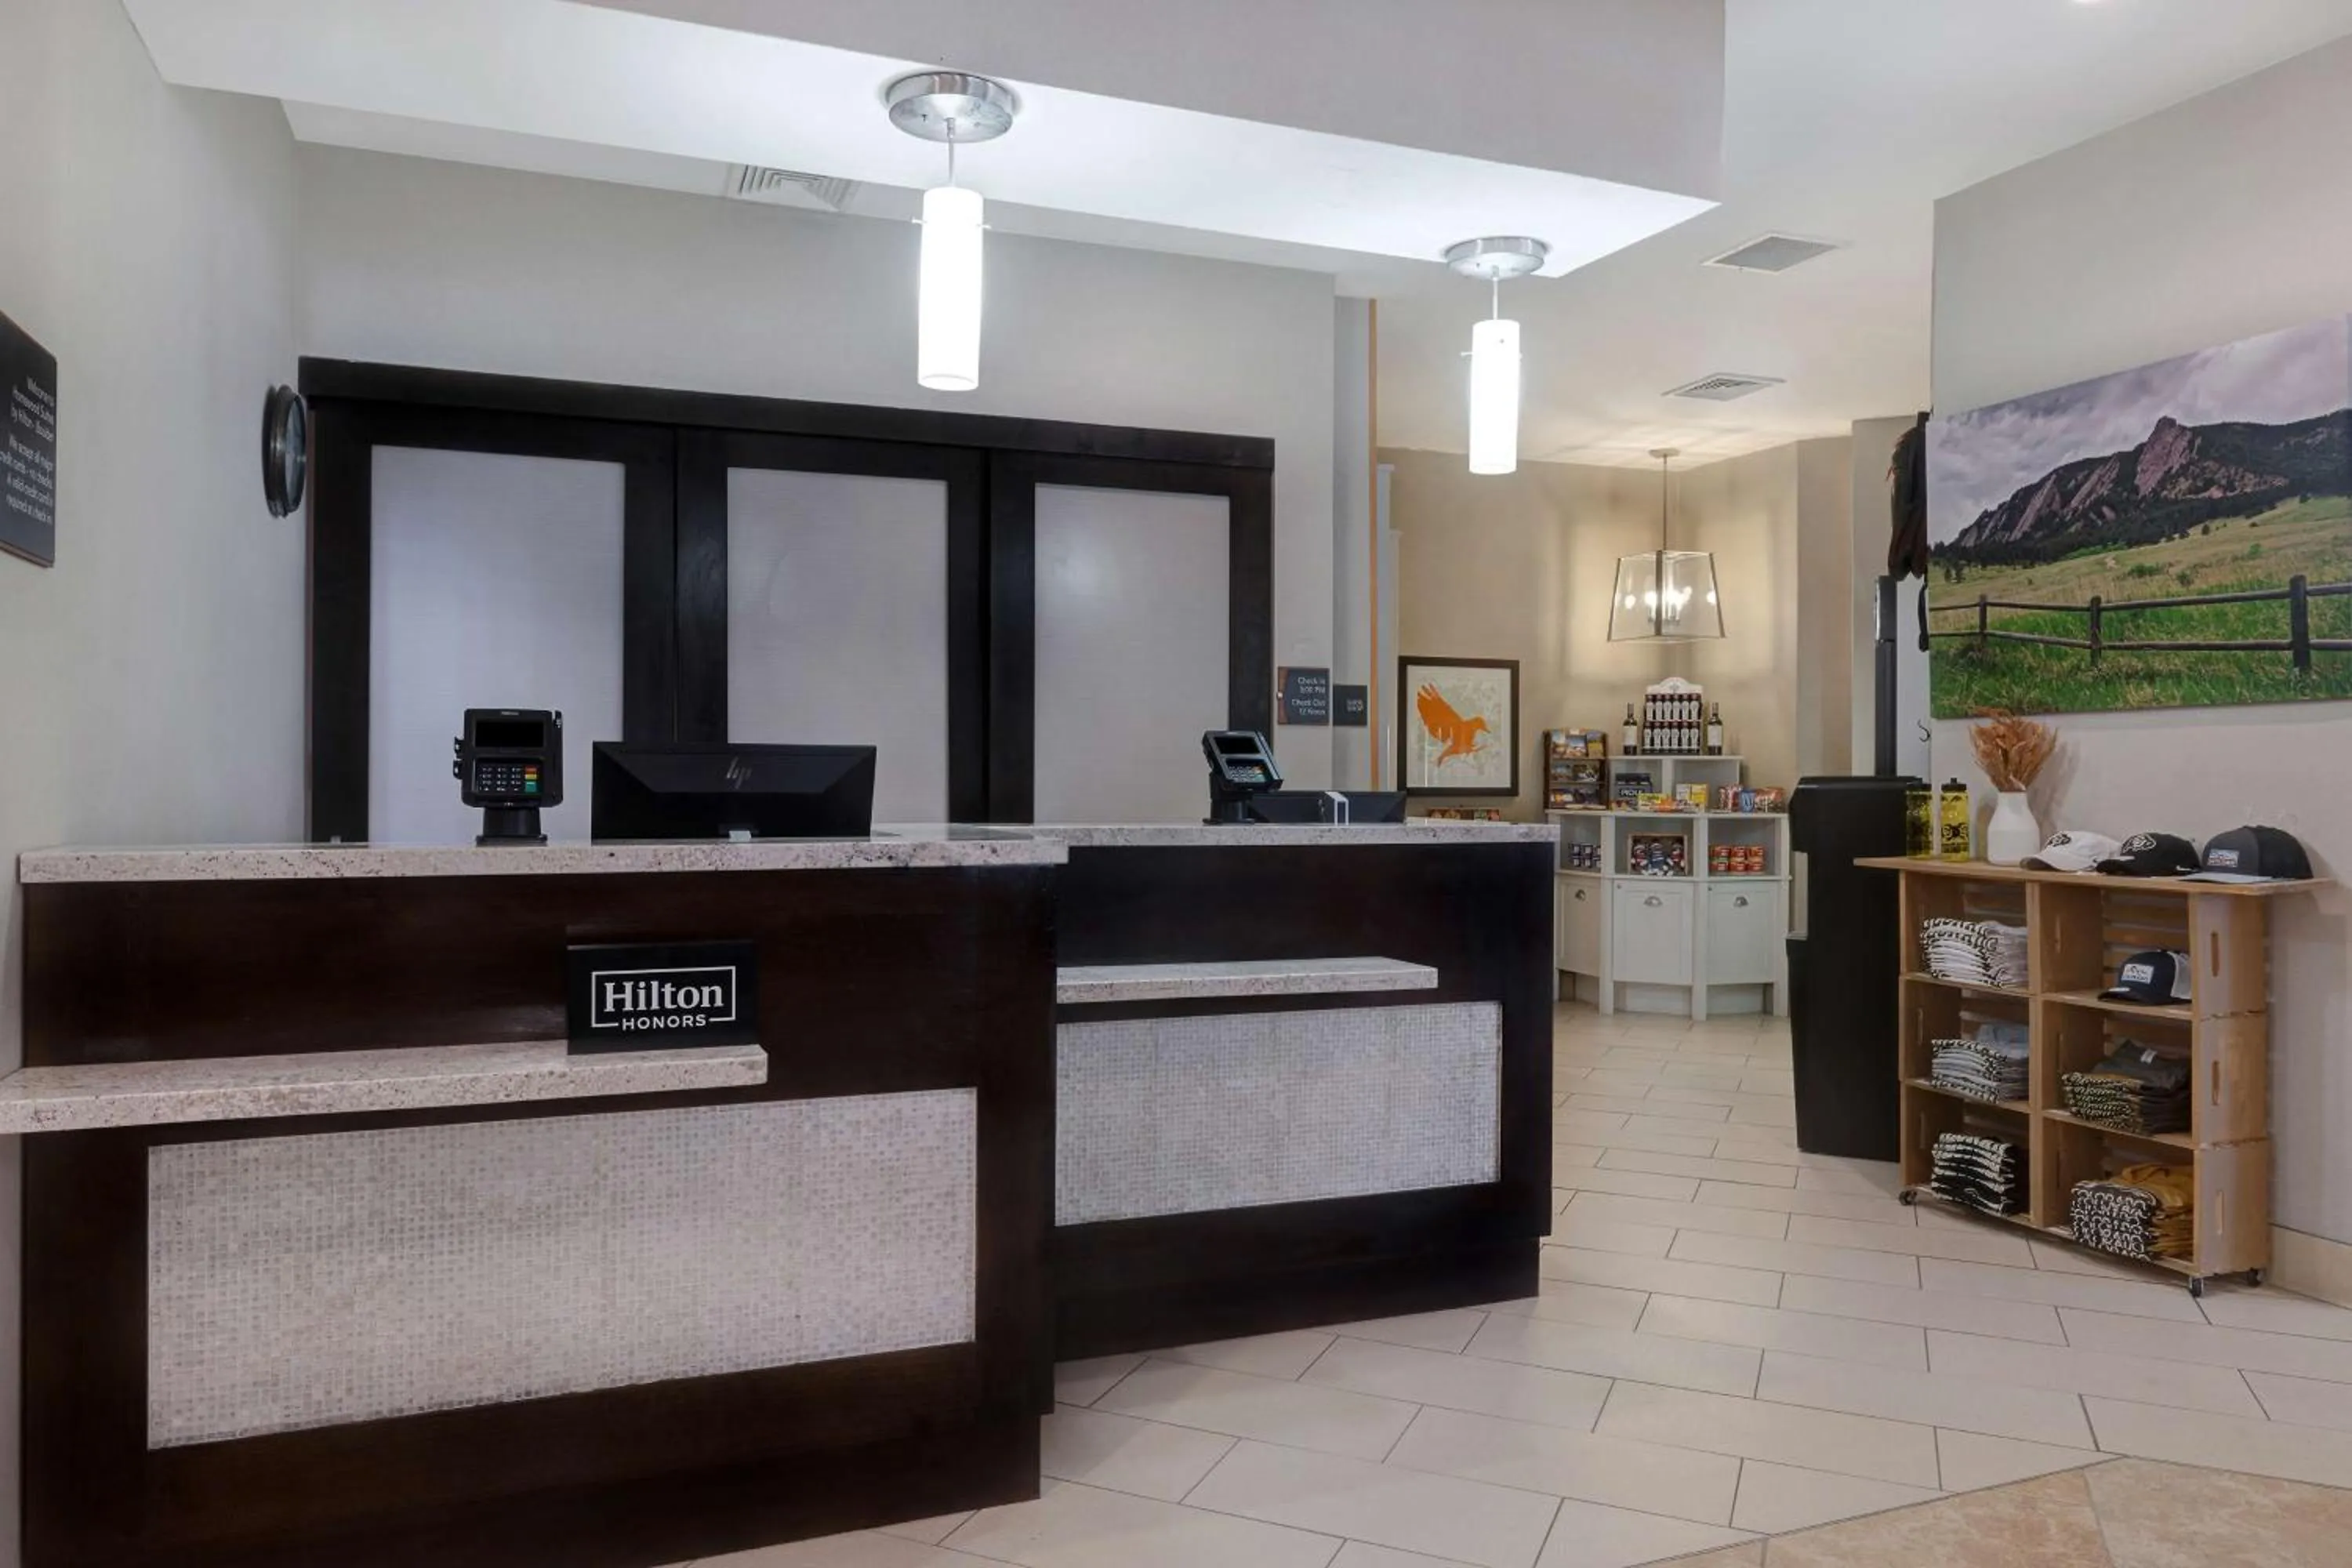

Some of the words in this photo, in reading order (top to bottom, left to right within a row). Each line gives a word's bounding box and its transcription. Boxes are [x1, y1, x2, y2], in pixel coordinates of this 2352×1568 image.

[727, 756, 753, 789] hp
[604, 981, 724, 1012] Hilton
[622, 1014, 706, 1031] HONORS
